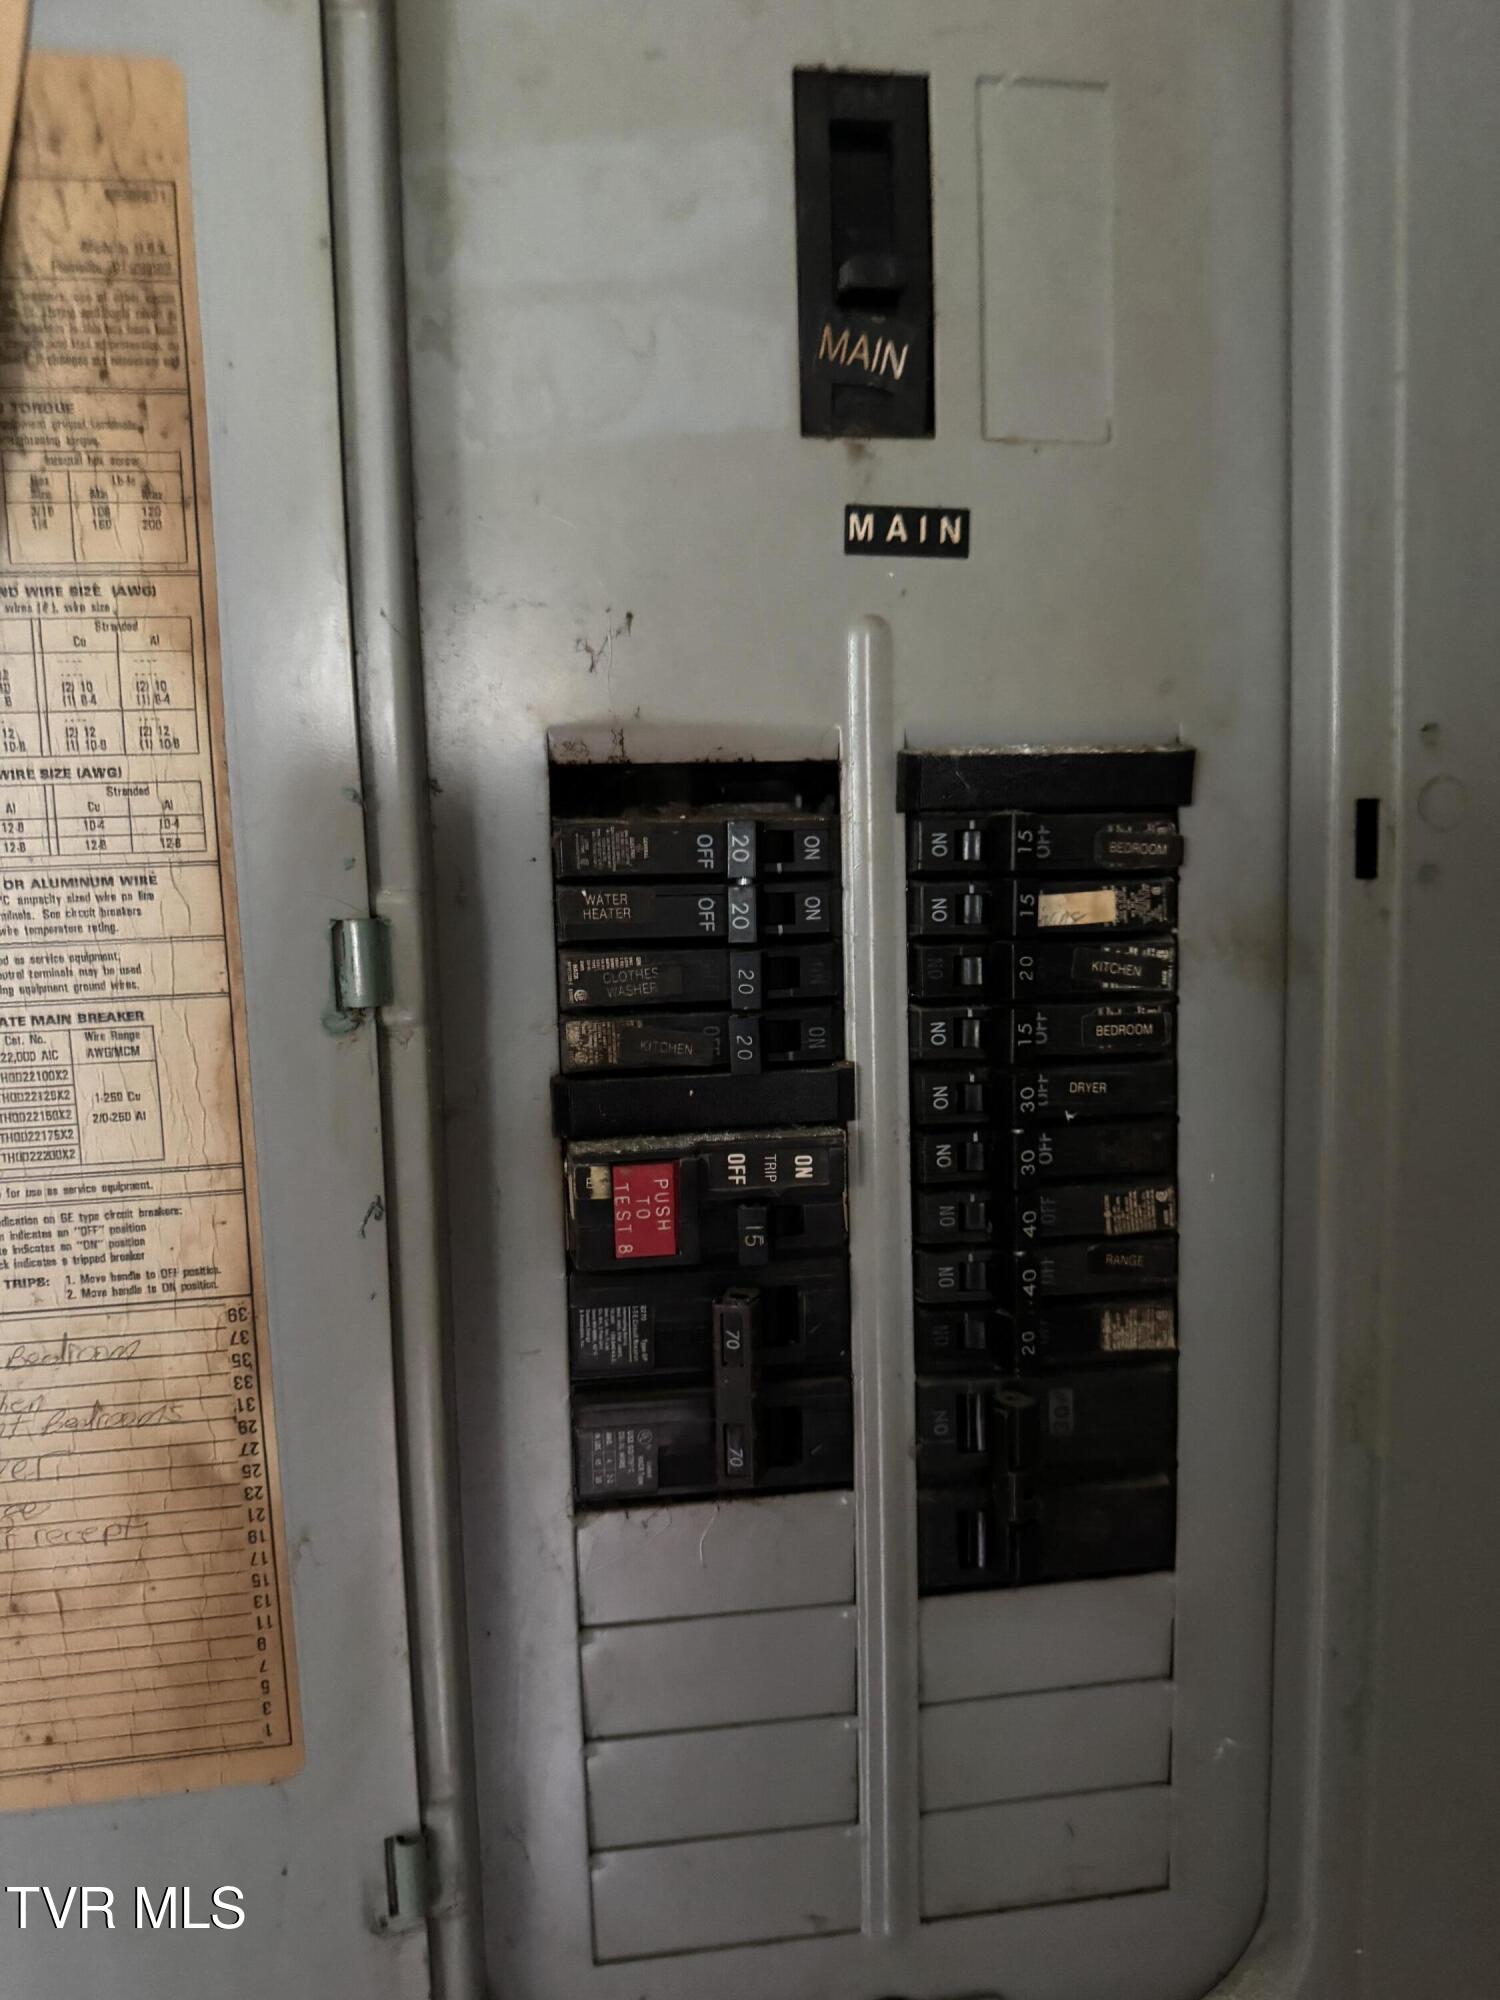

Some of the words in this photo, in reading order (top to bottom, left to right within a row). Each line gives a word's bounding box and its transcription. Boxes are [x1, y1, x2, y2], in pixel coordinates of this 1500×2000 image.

[818, 322, 909, 380] MAIN
[848, 512, 962, 544] MAIN
[26, 586, 63, 597] WIRE
[70, 586, 101, 597] SIZE
[112, 585, 156, 597] (AWG)
[73, 636, 86, 647] Cu
[150, 635, 159, 646] Al
[81, 681, 93, 692] 10
[155, 680, 167, 692] 10
[84, 727, 96, 737] 12
[159, 726, 170, 736] 12
[40, 768, 72, 779] SIZE
[78, 767, 122, 779] (AWG)
[107, 786, 150, 797] Stranded
[6, 803, 16, 814] Al
[88, 802, 100, 812] Cu
[164, 800, 173, 811] Al
[731, 835, 750, 862] 20
[804, 835, 820, 860] ON
[931, 832, 947, 857] ON
[1017, 830, 1033, 853] 15
[1109, 842, 1167, 855] BEDROOM
[696, 834, 714, 869] OFF
[4, 880, 24, 890] OR
[31, 876, 114, 889] ALUMINUM
[120, 874, 157, 886] WIRE
[583, 894, 628, 905] WATER
[1019, 894, 1035, 918] 15
[101, 907, 141, 917] breakers
[583, 908, 632, 920] HEATER
[698, 897, 715, 932] OFF
[804, 896, 821, 921] ON
[931, 897, 947, 922] ON
[731, 903, 750, 930] 20
[25, 924, 83, 938] temperature
[30, 954, 64, 965] service
[30, 967, 74, 978] terminals
[79, 966, 98, 979] may
[1019, 956, 1035, 981] 20
[1091, 962, 1142, 977] KITCHEN
[602, 968, 658, 985] CLOTHES
[738, 969, 754, 994] 20
[74, 980, 106, 995] ground
[606, 982, 657, 999] WASHER
[31, 1014, 72, 1026] MAIN
[78, 1011, 145, 1023] BREAKER
[85, 1032, 106, 1042] Wire
[111, 1031, 140, 1042] Range
[808, 1026, 825, 1049] ON
[930, 1021, 946, 1046] ON
[1017, 1023, 1033, 1046] 15
[1095, 1024, 1153, 1037] BEDROOM
[41, 1050, 59, 1060] AIC
[640, 1040, 693, 1055] KITCHEN
[736, 1035, 752, 1060] 20
[1069, 1082, 1107, 1094] DRYER
[127, 1092, 141, 1101] Cu
[932, 1085, 949, 1110] ON
[1020, 1087, 1035, 1112] 30
[936, 1144, 952, 1168] ON
[1020, 1150, 1036, 1175] 30
[727, 1153, 746, 1185] OFF
[764, 1154, 777, 1183] TRIP
[794, 1155, 813, 1179] ON
[7, 1188, 20, 1198] for
[63, 1184, 97, 1195] service
[614, 1183, 632, 1233] TEST
[635, 1195, 650, 1219] TO
[653, 1179, 672, 1231] PUSH
[60, 1211, 74, 1223] GE
[79, 1212, 99, 1223] type
[939, 1205, 955, 1227] ON
[109, 1223, 147, 1236] position
[1022, 1210, 1038, 1238] 40
[744, 1225, 764, 1247] 15
[108, 1238, 145, 1250] position
[618, 1245, 633, 1254] 8
[73, 1253, 106, 1267] tripped
[1105, 1254, 1144, 1267] RANGE
[4, 1278, 50, 1289] TRIPS:
[80, 1273, 106, 1284] Move
[110, 1270, 141, 1281] handle
[938, 1266, 955, 1288] ON
[1022, 1269, 1037, 1296] 40
[82, 1287, 107, 1298] Move
[112, 1285, 142, 1296] handle
[230, 1330, 250, 1344] 37
[725, 1330, 740, 1349] 70
[1020, 1330, 1036, 1355] 20
[232, 1352, 252, 1368] 35
[234, 1375, 254, 1390] 33
[236, 1398, 255, 1412] 31
[933, 1409, 950, 1436] ON
[239, 1441, 259, 1456] 27
[728, 1448, 744, 1467] 70
[242, 1463, 262, 1478] 25
[244, 1485, 264, 1500] 23
[248, 1508, 265, 1522] 21
[250, 1551, 269, 1566] 17
[252, 1573, 270, 1588] 15
[254, 1594, 272, 1608] 13
[256, 1615, 273, 1630] 11
[259, 1659, 267, 1673] 7
[262, 1701, 272, 1715] 3
